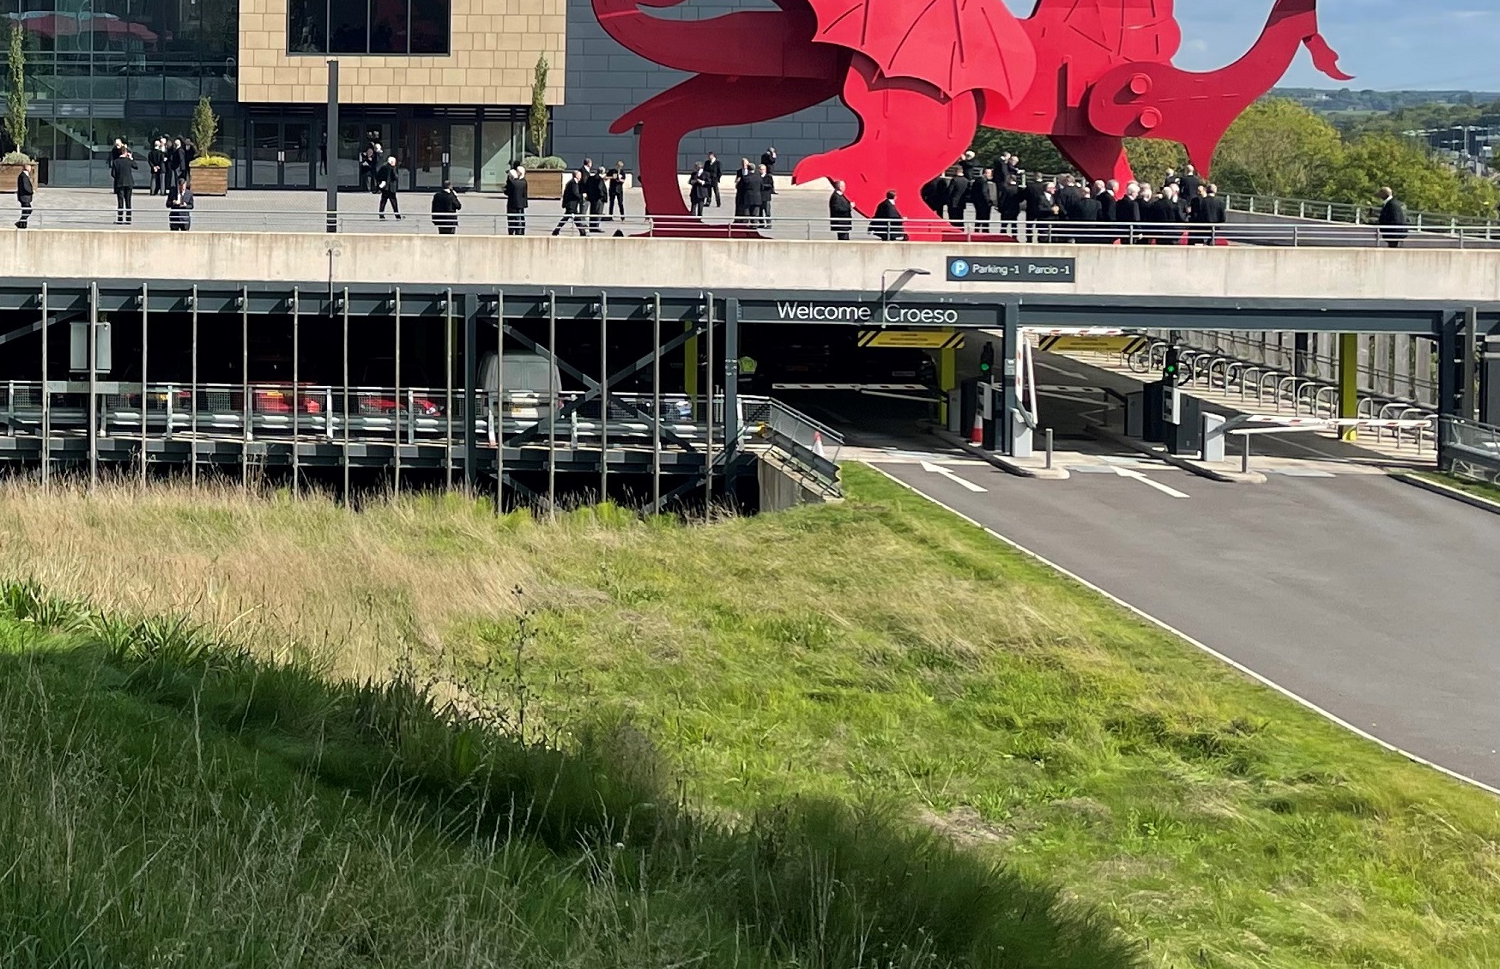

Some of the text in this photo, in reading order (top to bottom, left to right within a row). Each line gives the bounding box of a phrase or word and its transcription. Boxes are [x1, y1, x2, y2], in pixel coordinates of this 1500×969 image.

[955, 262, 1070, 276] P Parking -1 Parcio -1
[777, 301, 958, 323] Welcome Croeso
